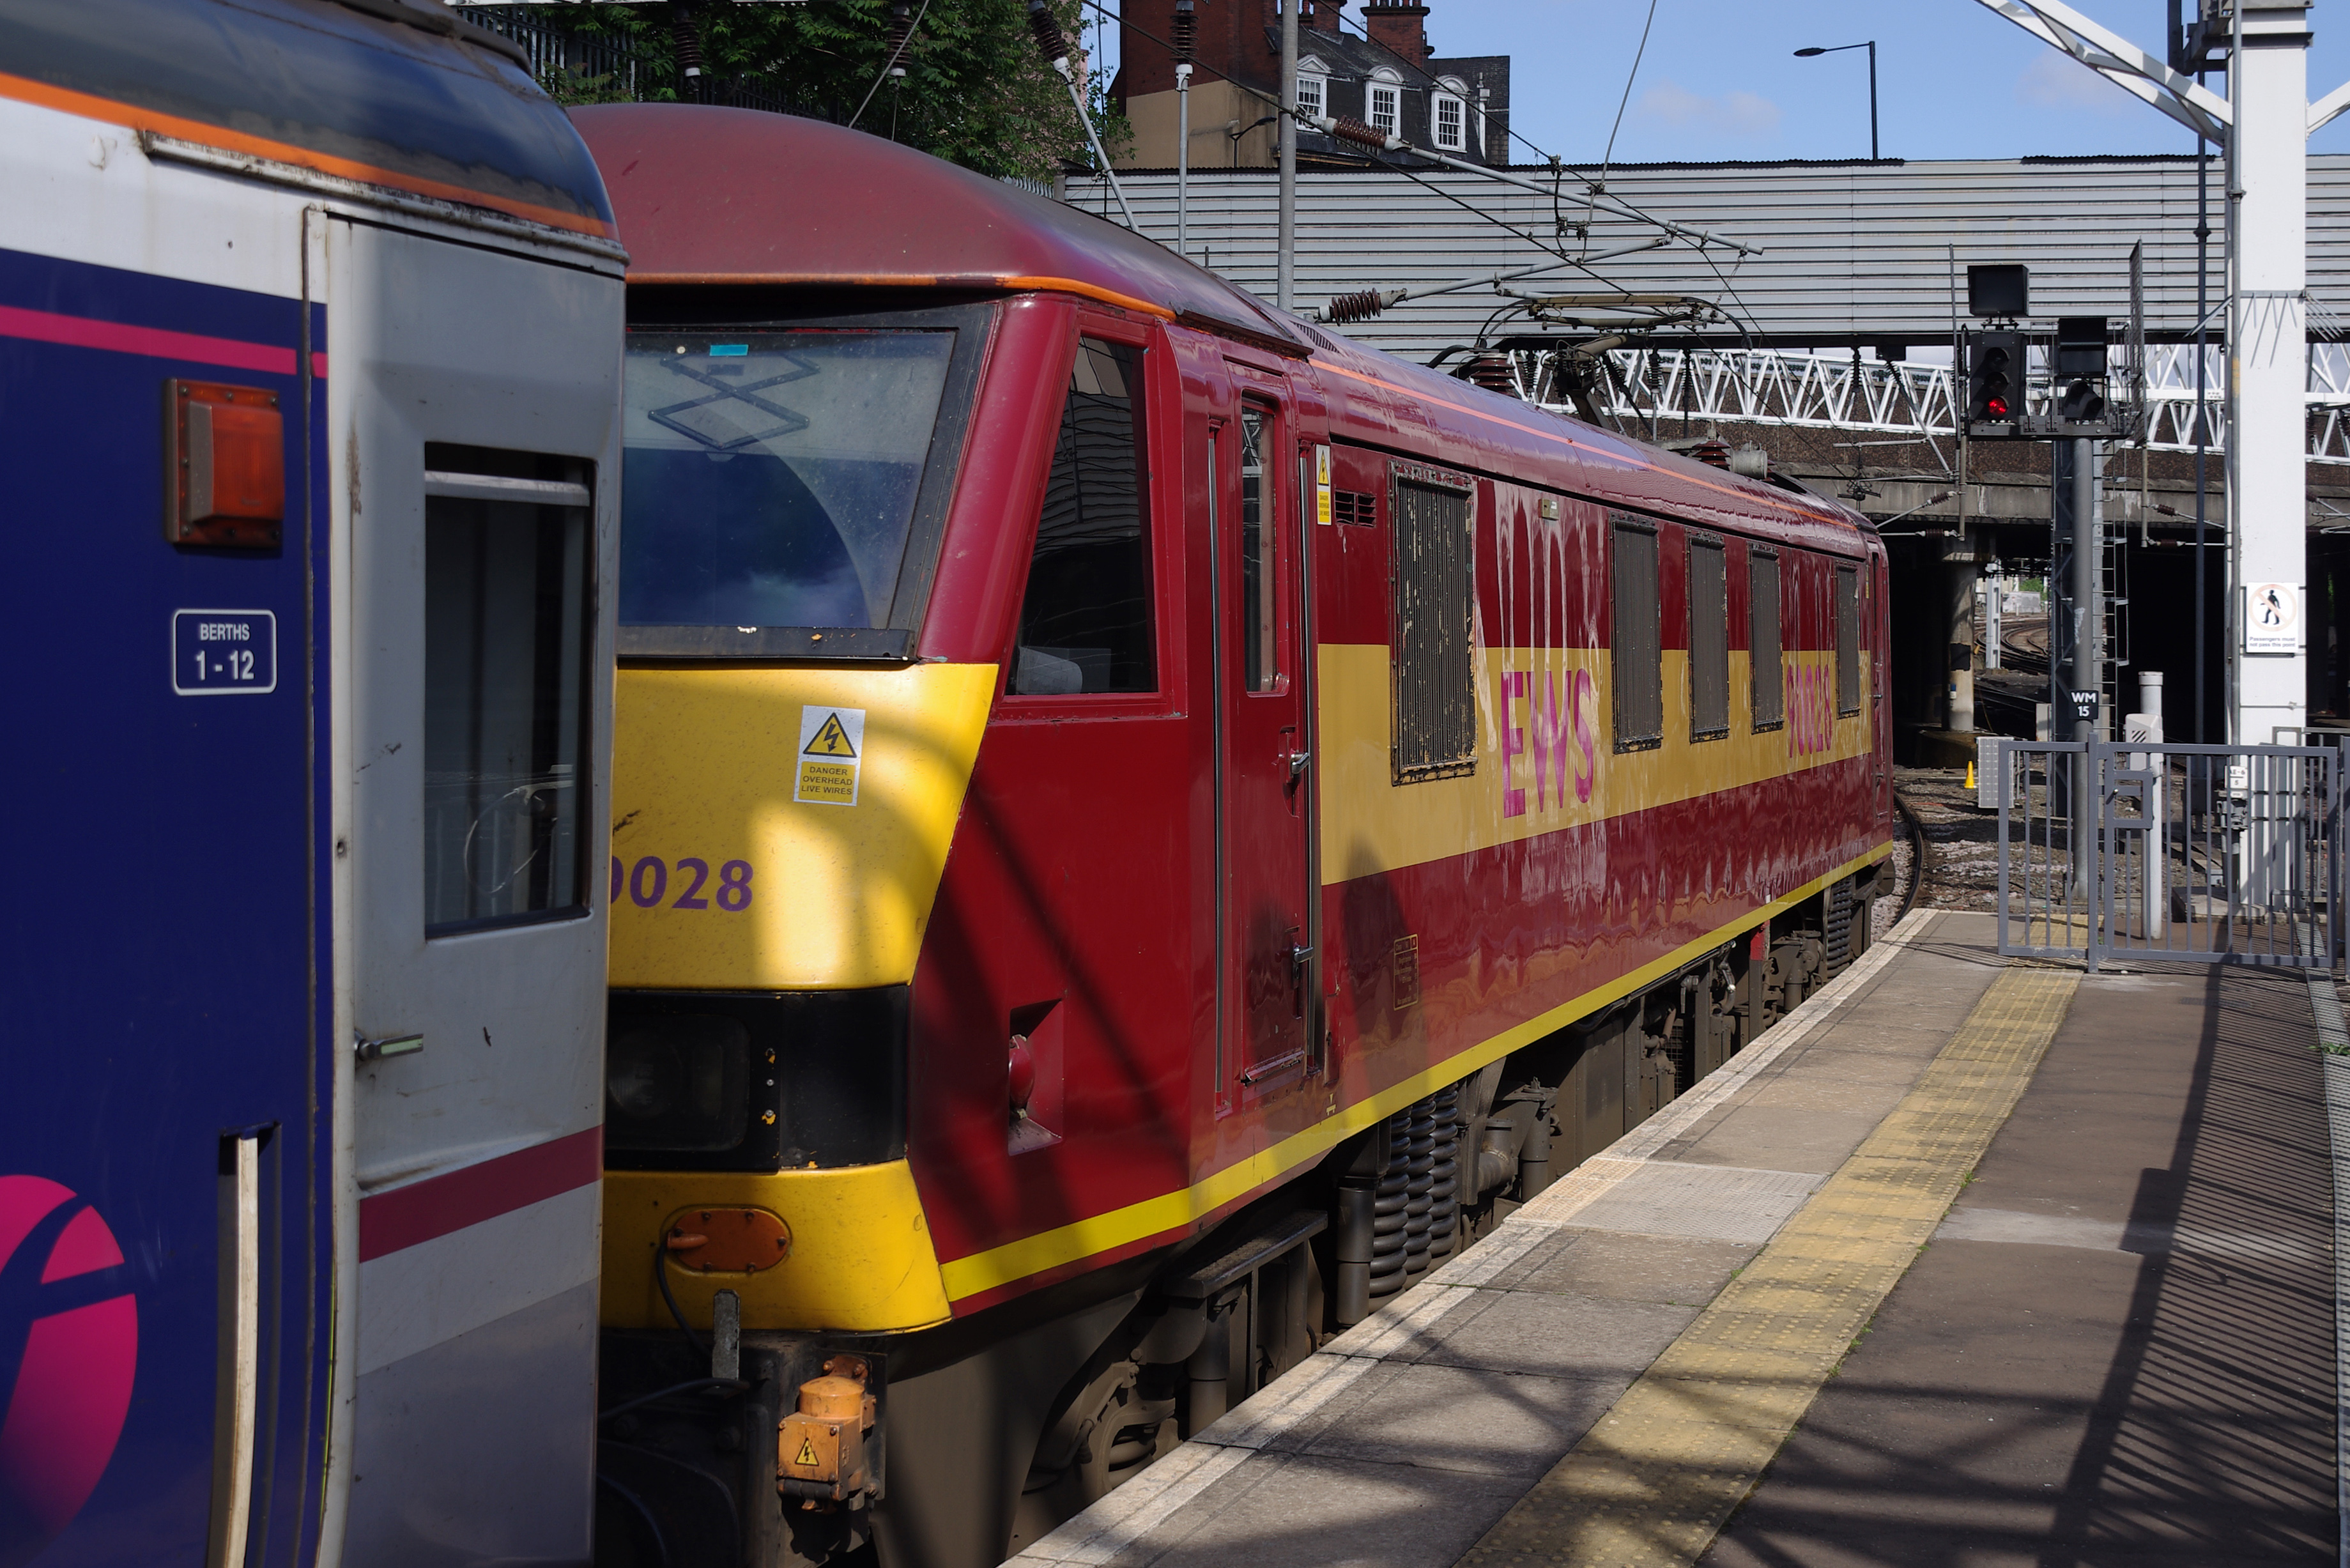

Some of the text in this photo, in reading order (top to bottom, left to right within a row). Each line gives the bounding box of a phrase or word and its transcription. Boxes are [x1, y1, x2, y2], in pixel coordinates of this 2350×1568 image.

[200, 624, 250, 641] BERTHS
[2071, 691, 2096, 703] WM
[1786, 664, 1832, 758] 90028
[2077, 705, 2090, 717] 15
[1500, 667, 1594, 819] EWS
[810, 766, 848, 776] DANGER
[803, 775, 852, 785] OVERHEAD
[801, 785, 852, 795] LIVE WIRES
